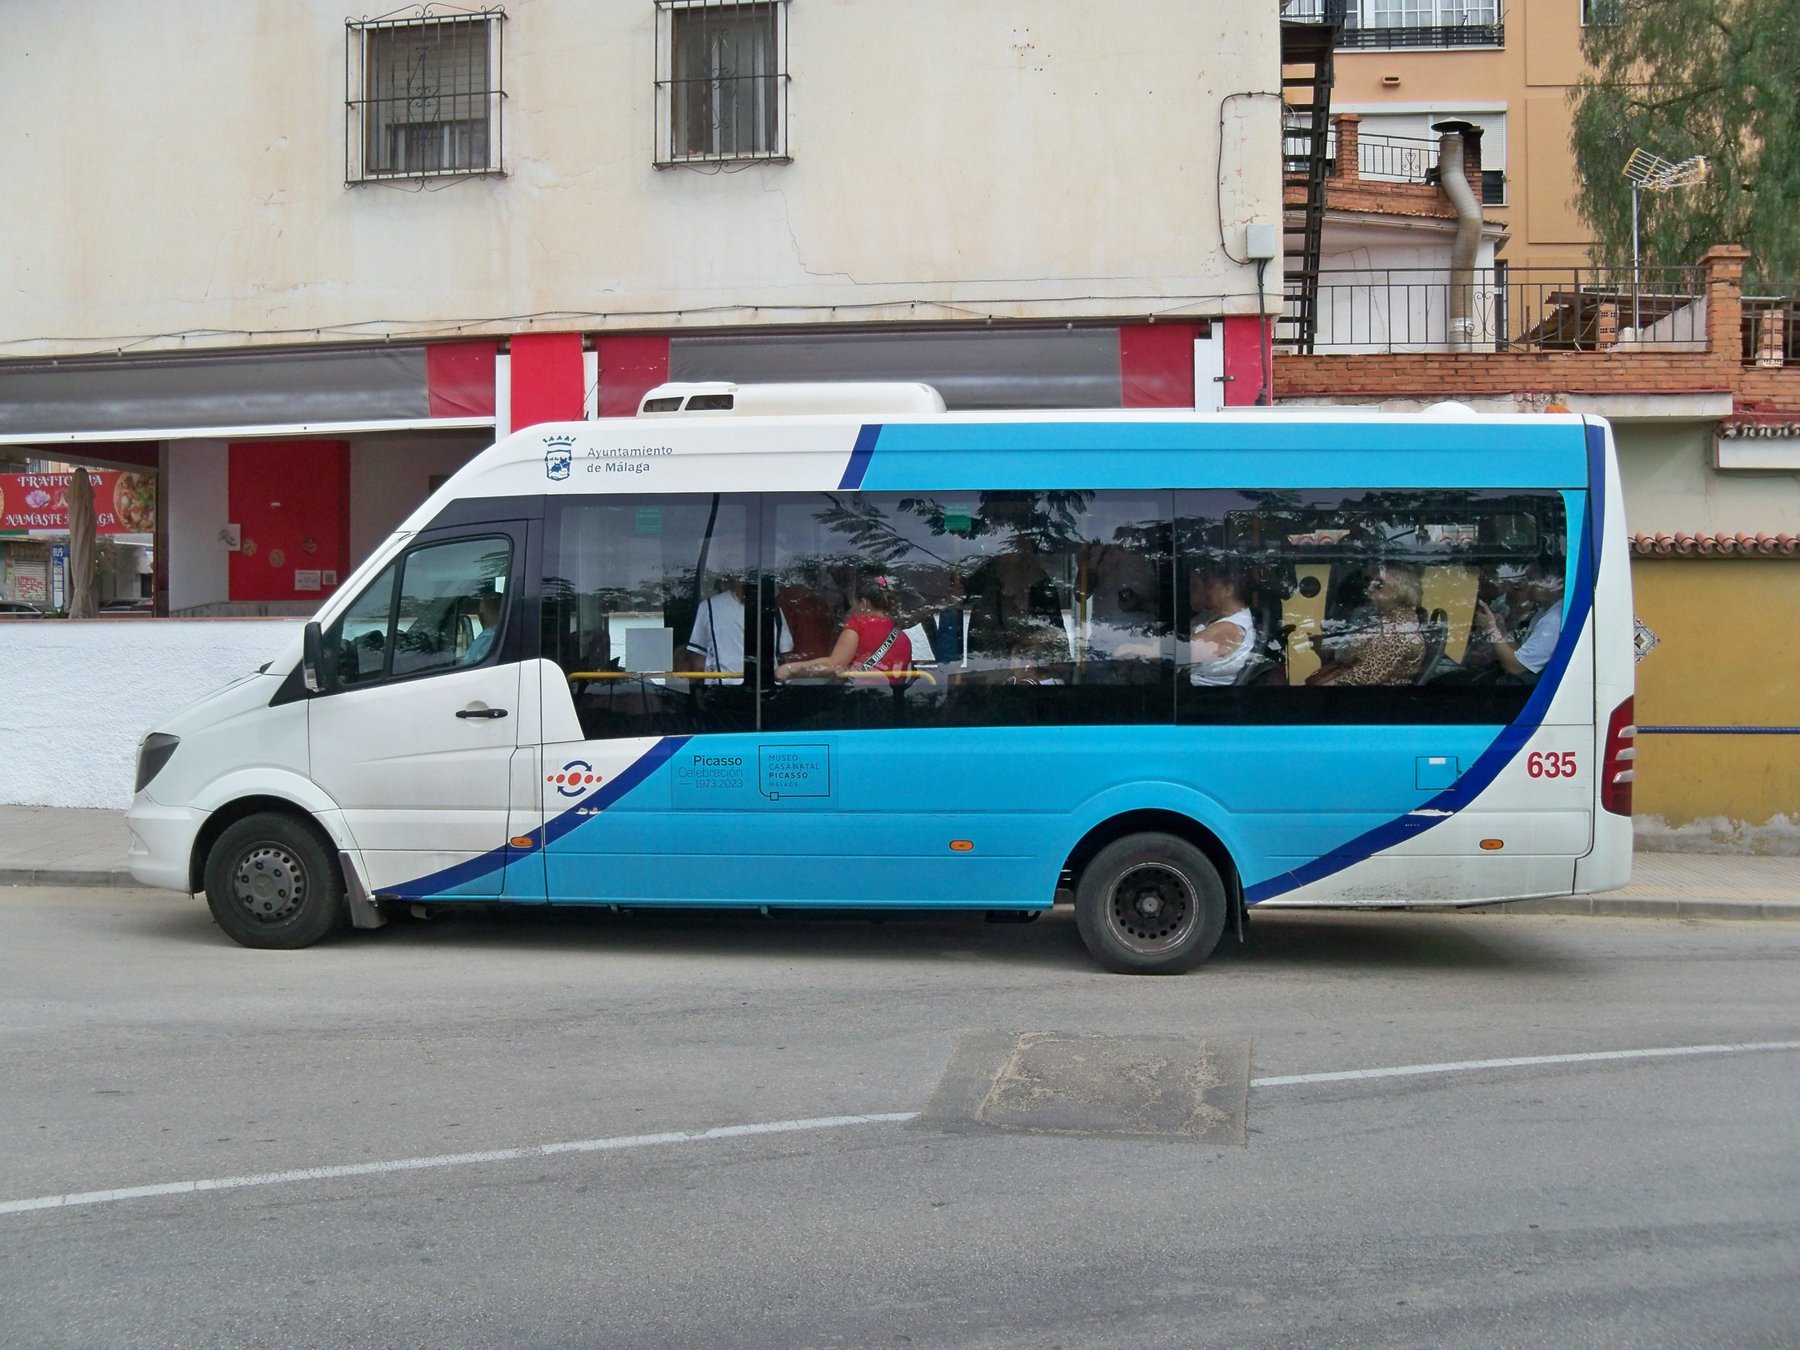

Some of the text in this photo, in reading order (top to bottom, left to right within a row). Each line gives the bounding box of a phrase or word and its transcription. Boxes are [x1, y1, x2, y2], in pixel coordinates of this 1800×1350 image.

[587, 445, 673, 460] Ayuntamiento
[587, 461, 650, 474] de Málaga
[5, 512, 63, 527] NAMASTE
[52, 547, 63, 557] BUS
[693, 755, 743, 766] Picasso
[768, 754, 799, 762] MUSEO
[1527, 751, 1577, 779] 635
[678, 766, 743, 778] Celebración
[768, 771, 809, 779] PICASSO
